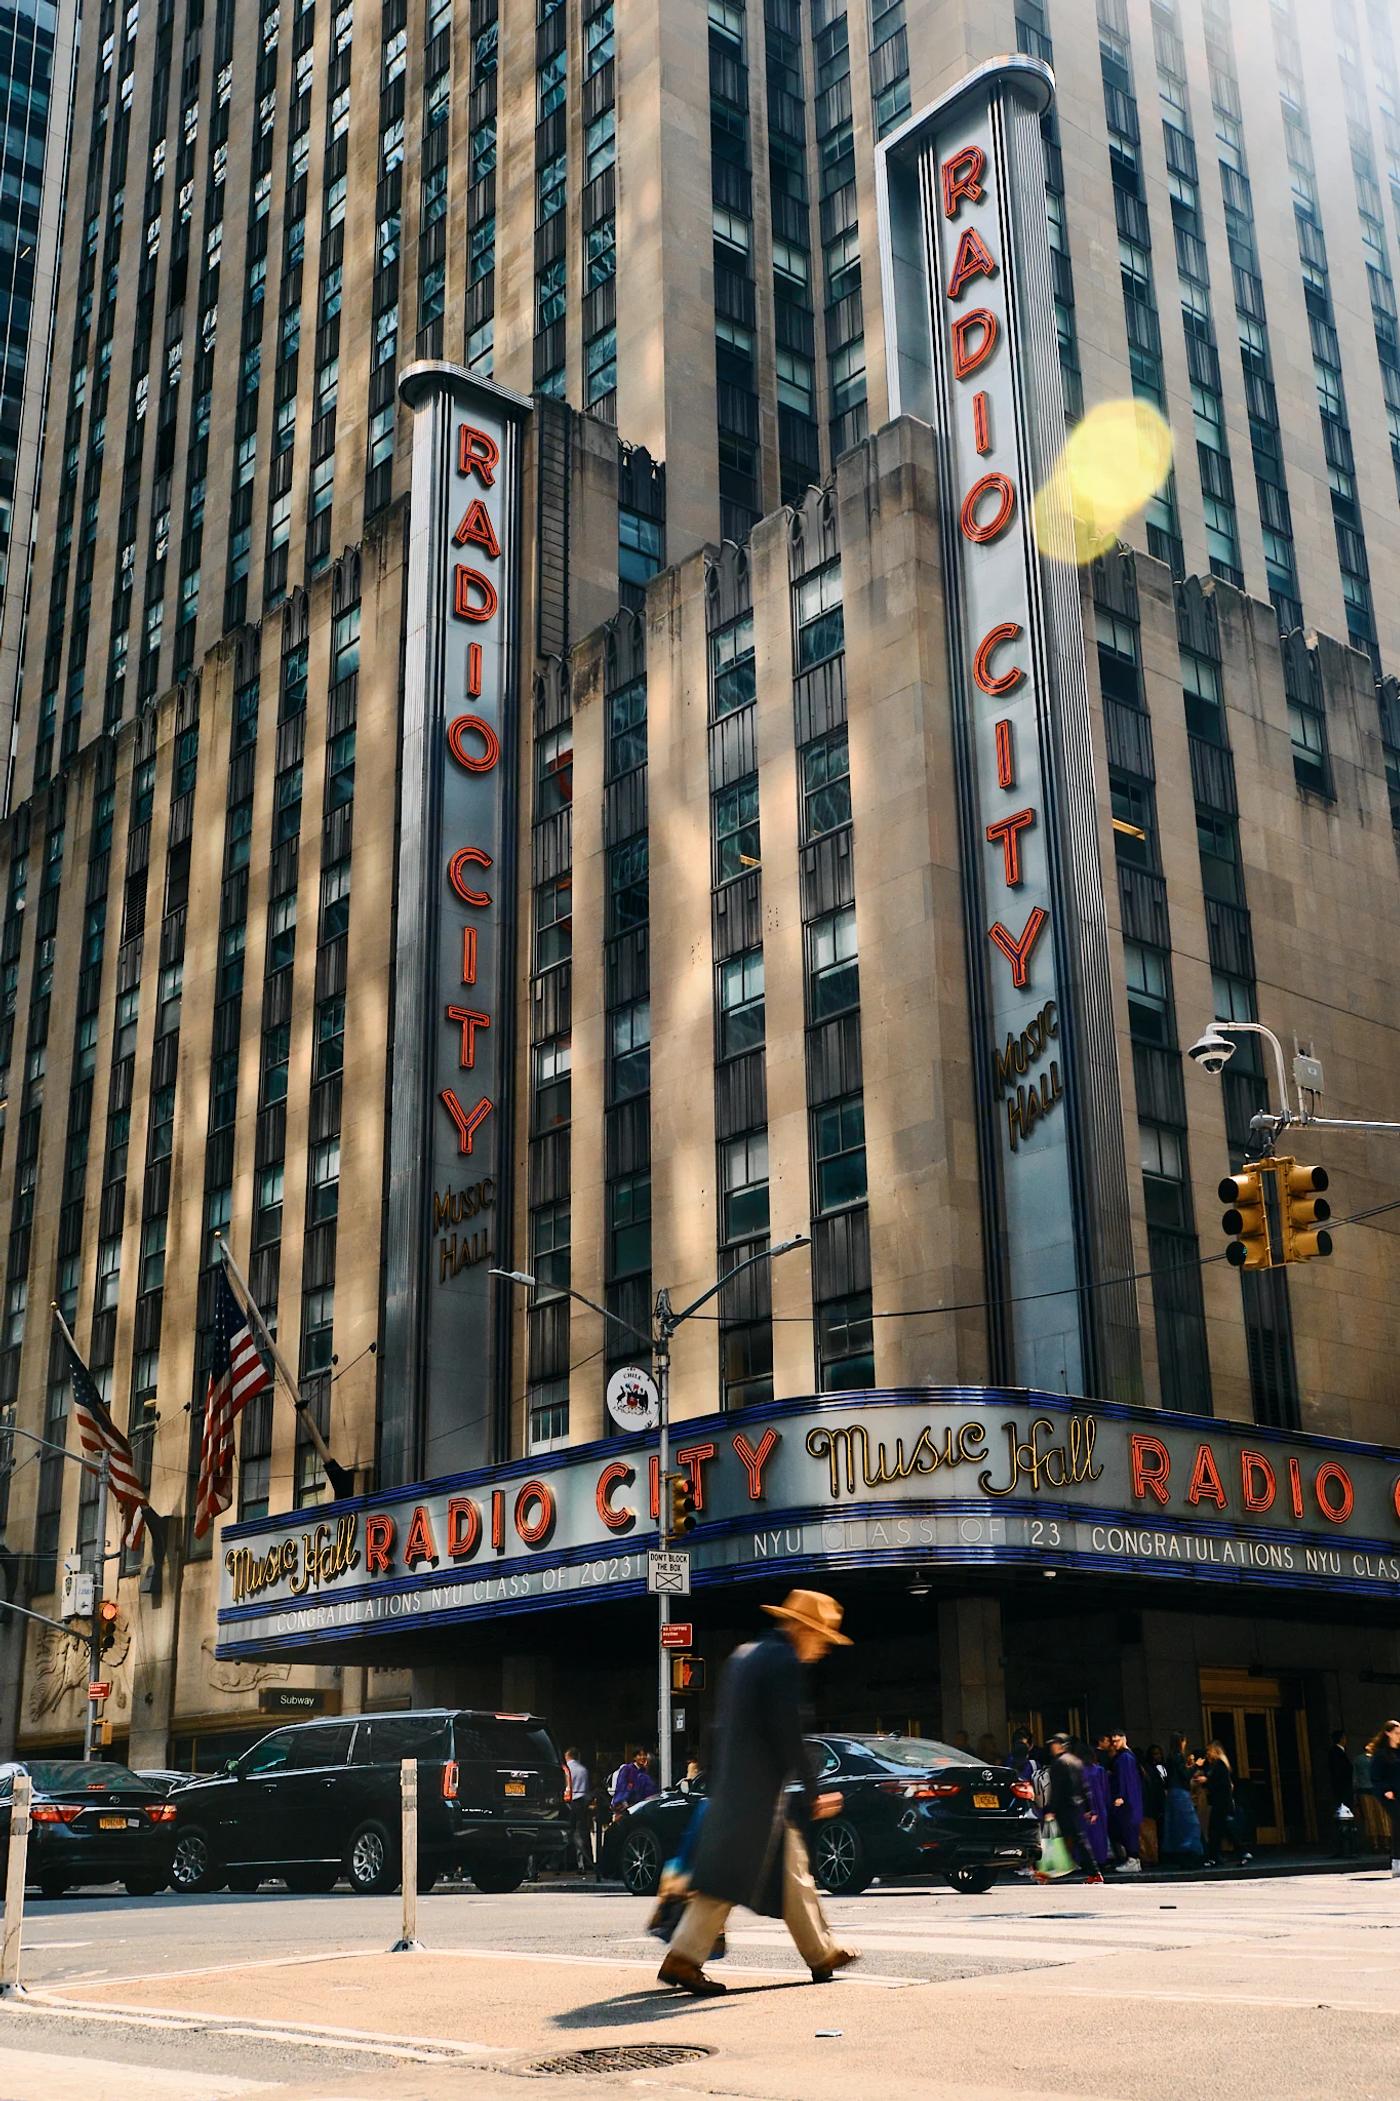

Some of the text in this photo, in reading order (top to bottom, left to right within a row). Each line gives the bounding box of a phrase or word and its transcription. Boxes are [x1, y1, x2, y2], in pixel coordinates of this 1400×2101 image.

[941, 144, 1049, 989] RADIO CITY
[439, 422, 501, 1155] RADIO CITY
[994, 1000, 1058, 1101] MUSIC
[1007, 1061, 1062, 1152] HALL
[433, 1178, 496, 1236] MUSIC
[439, 1228, 495, 1284] HALL
[806, 1415, 1104, 1498] Music Hall
[1131, 1433, 1354, 1524] RADIO
[366, 1428, 777, 1572] RADIO CITY
[754, 1528, 801, 1558] NYU
[823, 1519, 934, 1550] CLASS
[961, 1517, 1003, 1543] OF
[225, 1511, 360, 1602] Music Hall
[668, 1554, 687, 1563] BLOCK
[669, 1563, 681, 1571] BOX
[1092, 1527, 1294, 1569] CONGRATULATIONS
[1306, 1549, 1342, 1574] NYU
[276, 1554, 641, 1633] CONGRATULATIONS NYU CLASS OF 2023!
[280, 1694, 314, 1707] Subway
